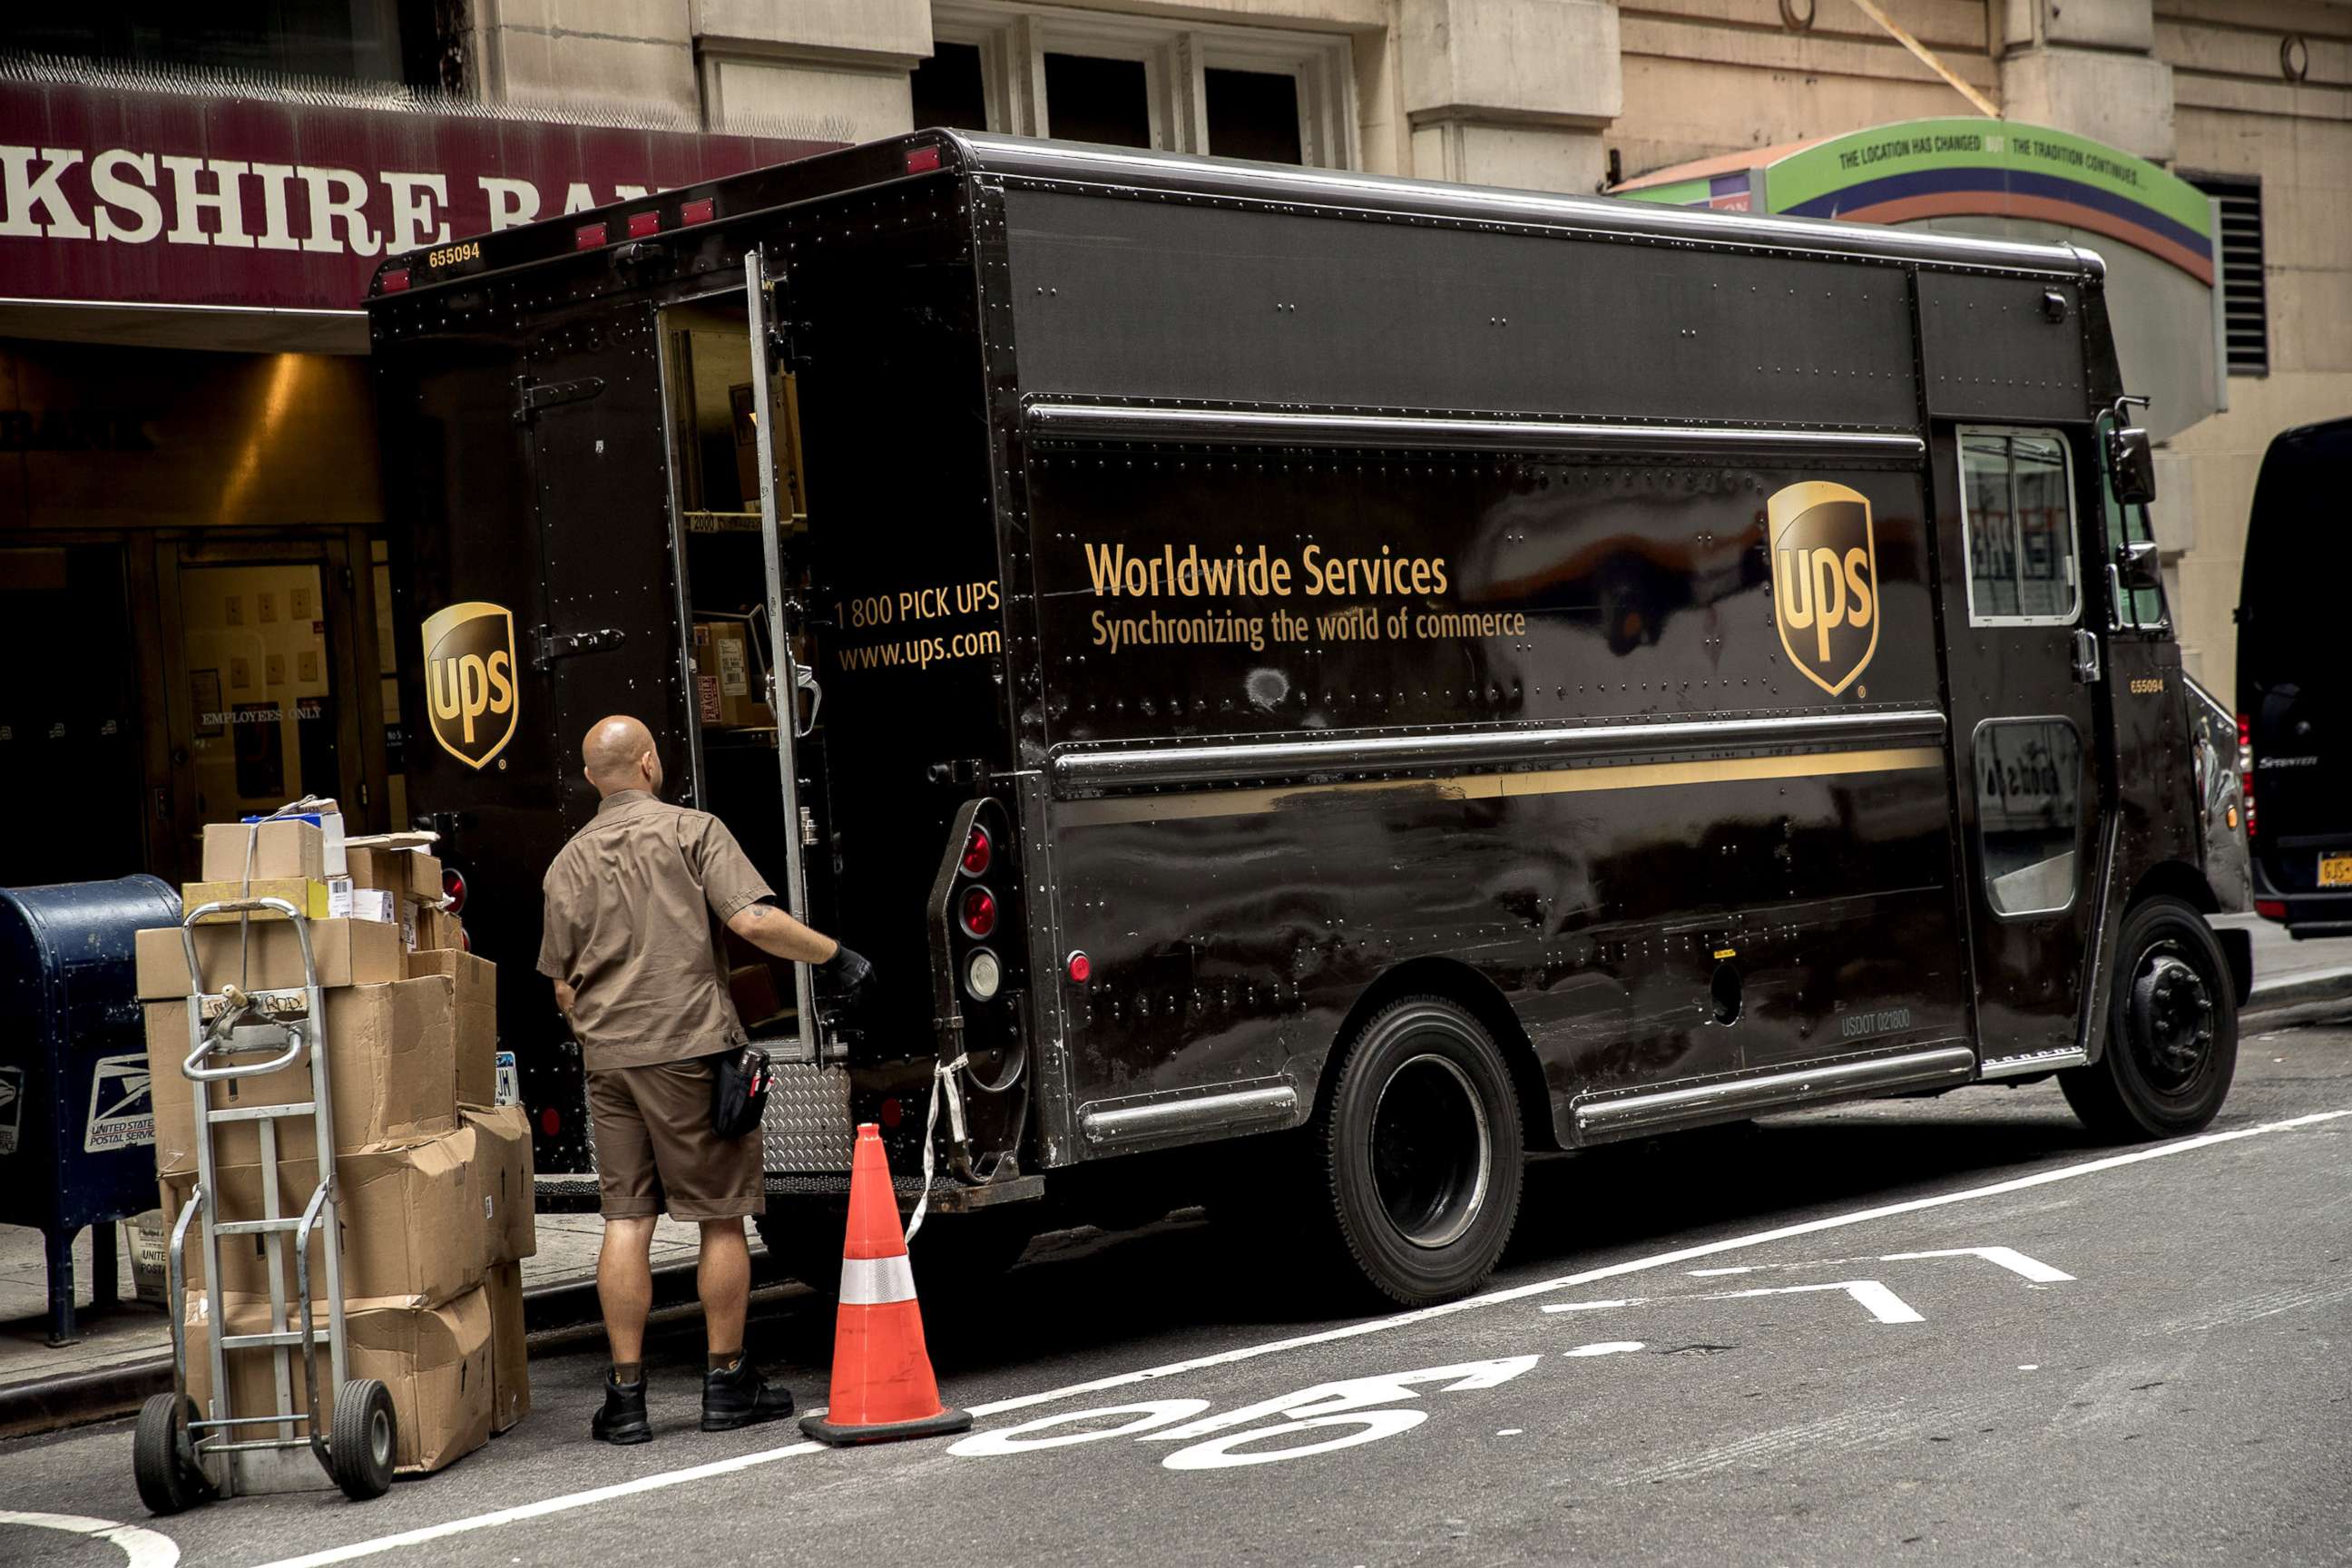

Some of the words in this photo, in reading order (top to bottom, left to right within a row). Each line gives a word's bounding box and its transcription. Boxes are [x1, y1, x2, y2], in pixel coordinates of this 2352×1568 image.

[1839, 150, 1860, 171] THE
[1860, 139, 1911, 165] LOCATION
[1911, 135, 1933, 155] HAS
[1935, 134, 1982, 152] CHANGED
[2012, 138, 2031, 156] THE
[2033, 140, 2084, 167] TRADITION
[429, 241, 480, 268] 655094
[1085, 543, 1292, 597] Worldwide
[1302, 544, 1447, 595] Services
[834, 601, 845, 630] 1
[851, 594, 893, 628] 800
[899, 586, 951, 622] PICK
[956, 580, 1000, 614] UPS
[1778, 546, 1873, 663] ups
[1092, 609, 1264, 654] Synchronizing
[1271, 608, 1309, 642] the
[1317, 608, 1379, 641] world
[1387, 606, 1409, 639] of
[1416, 612, 1526, 638] commerce
[839, 630, 1002, 671] www.ups.com
[431, 650, 513, 743] ups
[2130, 679, 2164, 694] 655094
[201, 709, 283, 726] EMPLOYEES
[288, 707, 322, 720] ONLY
[1842, 1014, 1877, 1036] USDOT
[90, 1132, 124, 1147] POSTAL
[92, 1122, 126, 1135] UNITED
